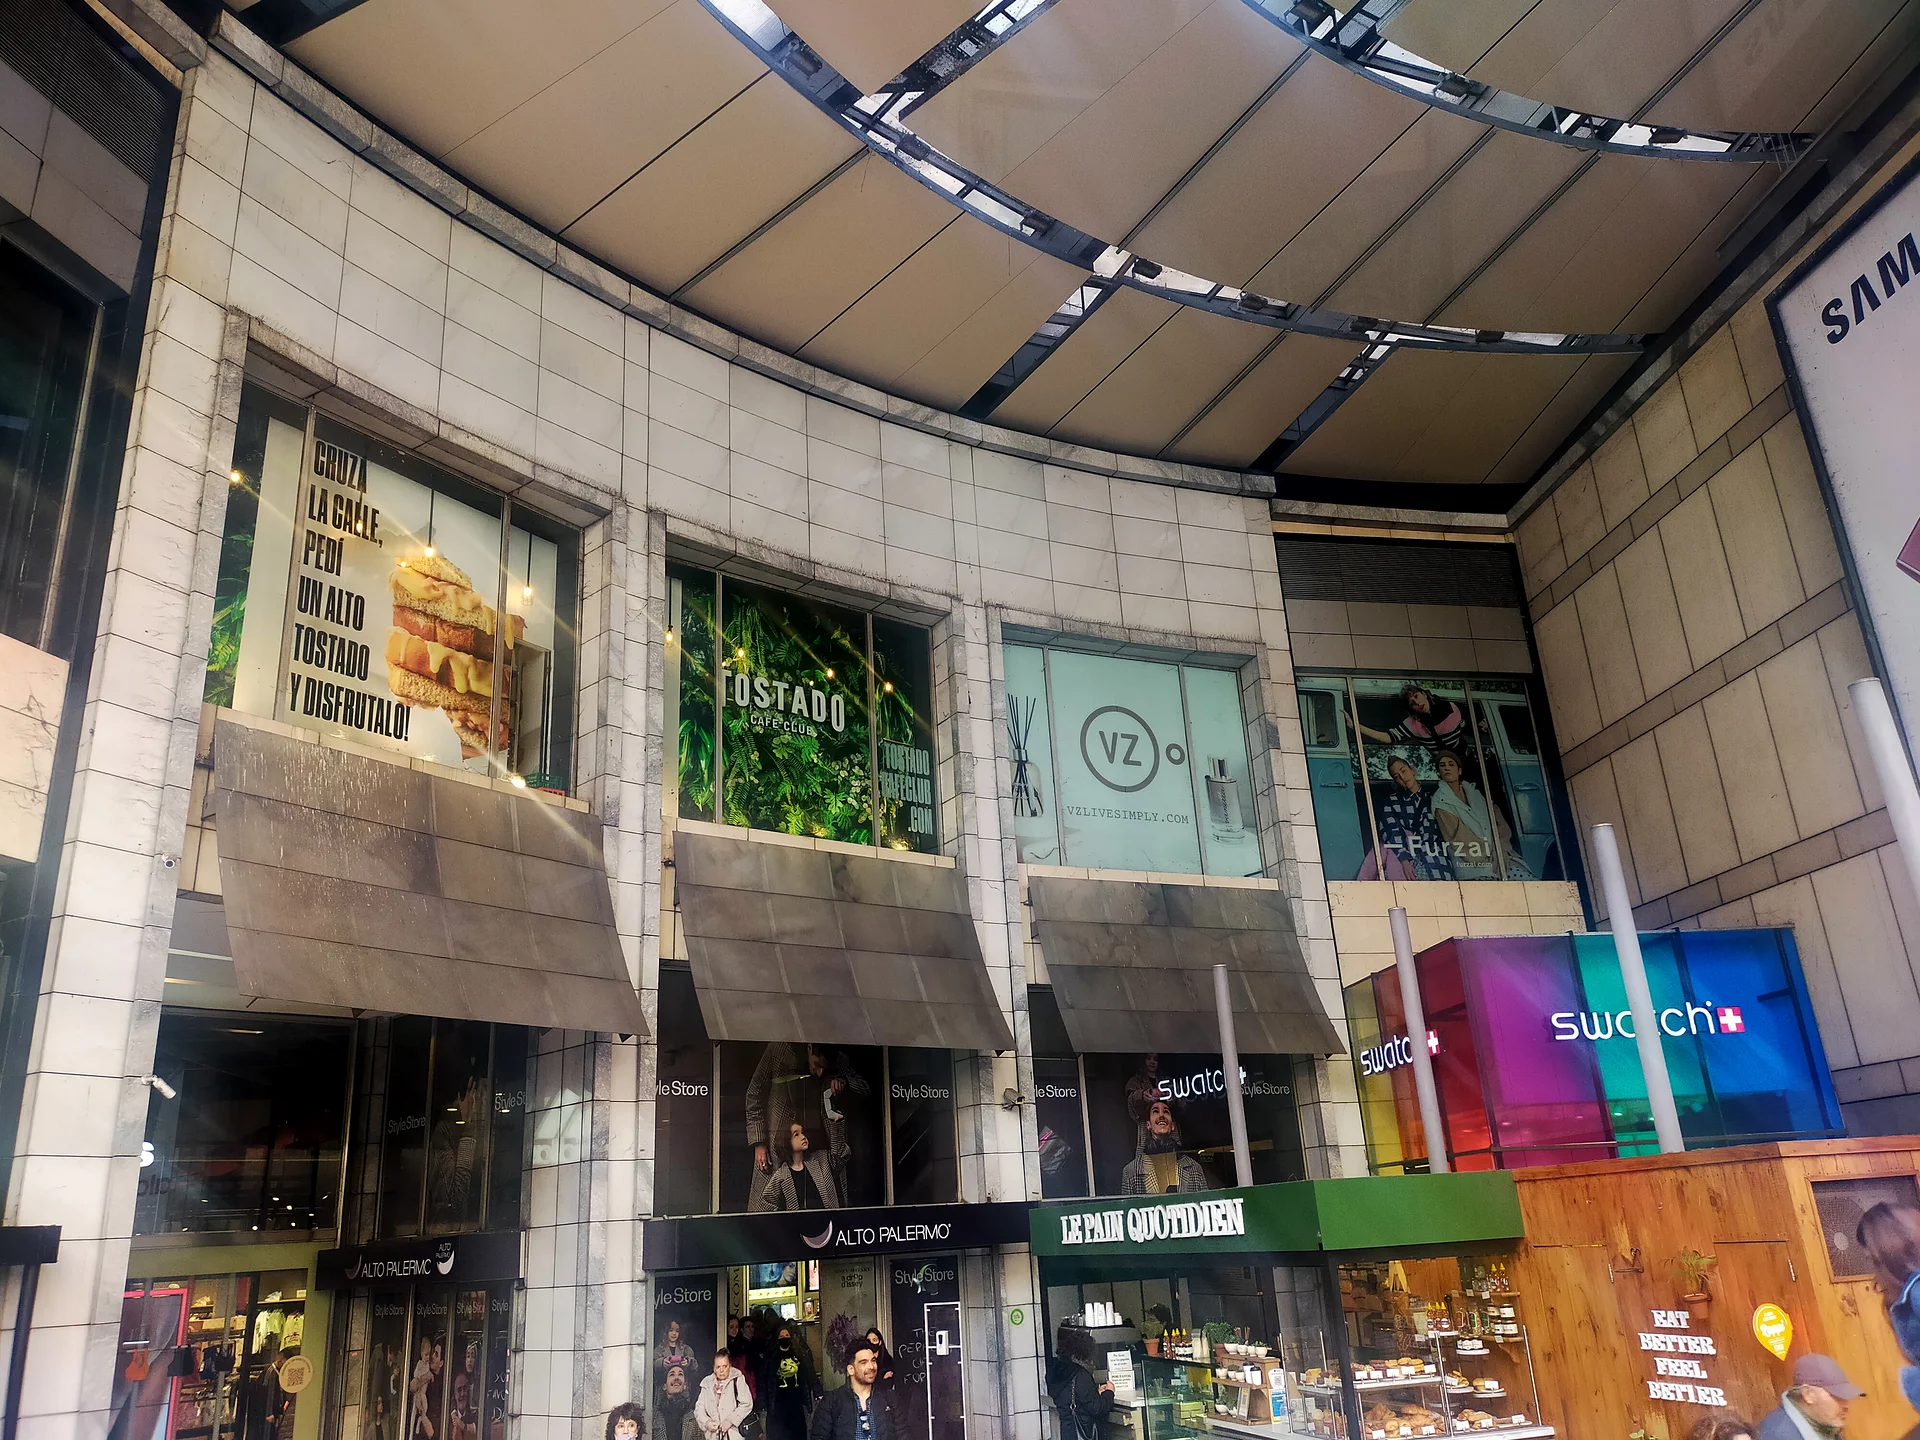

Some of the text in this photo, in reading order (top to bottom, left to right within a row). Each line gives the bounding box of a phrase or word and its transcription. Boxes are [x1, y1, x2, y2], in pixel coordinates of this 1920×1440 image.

[314, 440, 368, 493] CRUZA
[308, 484, 383, 549] LA CALLE,
[303, 529, 345, 577] PEDÍ
[297, 575, 365, 632] UN ALTO
[294, 623, 371, 682] TOSTADO
[290, 672, 412, 742] Y DISFRUTALO!
[721, 668, 845, 732] TOSTADO
[783, 721, 814, 736] CLUB
[884, 743, 930, 776] TOSTADO
[1099, 731, 1142, 767] VZ
[907, 806, 933, 835] .COM
[1067, 805, 1189, 824] VZLIVESIMPLY.COM
[1408, 836, 1491, 857] Furzai
[1551, 1001, 1715, 1040] swach
[1361, 1034, 1414, 1076] swatc
[671, 1080, 709, 1096] Store
[892, 1083, 949, 1100] Style Store
[1046, 1085, 1077, 1098] Store
[1262, 1082, 1290, 1095] Store
[388, 1115, 426, 1135] Style Store
[1060, 1198, 1245, 1245] LE PAIN QUOTIDIEN
[836, 1223, 949, 1247] ALTO PALERMO
[439, 1242, 451, 1251] ALTO
[361, 1262, 385, 1278] ALTO
[895, 1267, 954, 1287] Style Store
[674, 1287, 712, 1303] Store
[375, 1304, 405, 1318] Style Store
[416, 1303, 447, 1318] Style Store
[457, 1302, 472, 1318] Style
[491, 1299, 509, 1314] Style
[1651, 1309, 1690, 1329] EAT
[1637, 1332, 1717, 1355] BETTER
[1653, 1357, 1708, 1379] FEEL
[1646, 1380, 1728, 1406] BETTER
